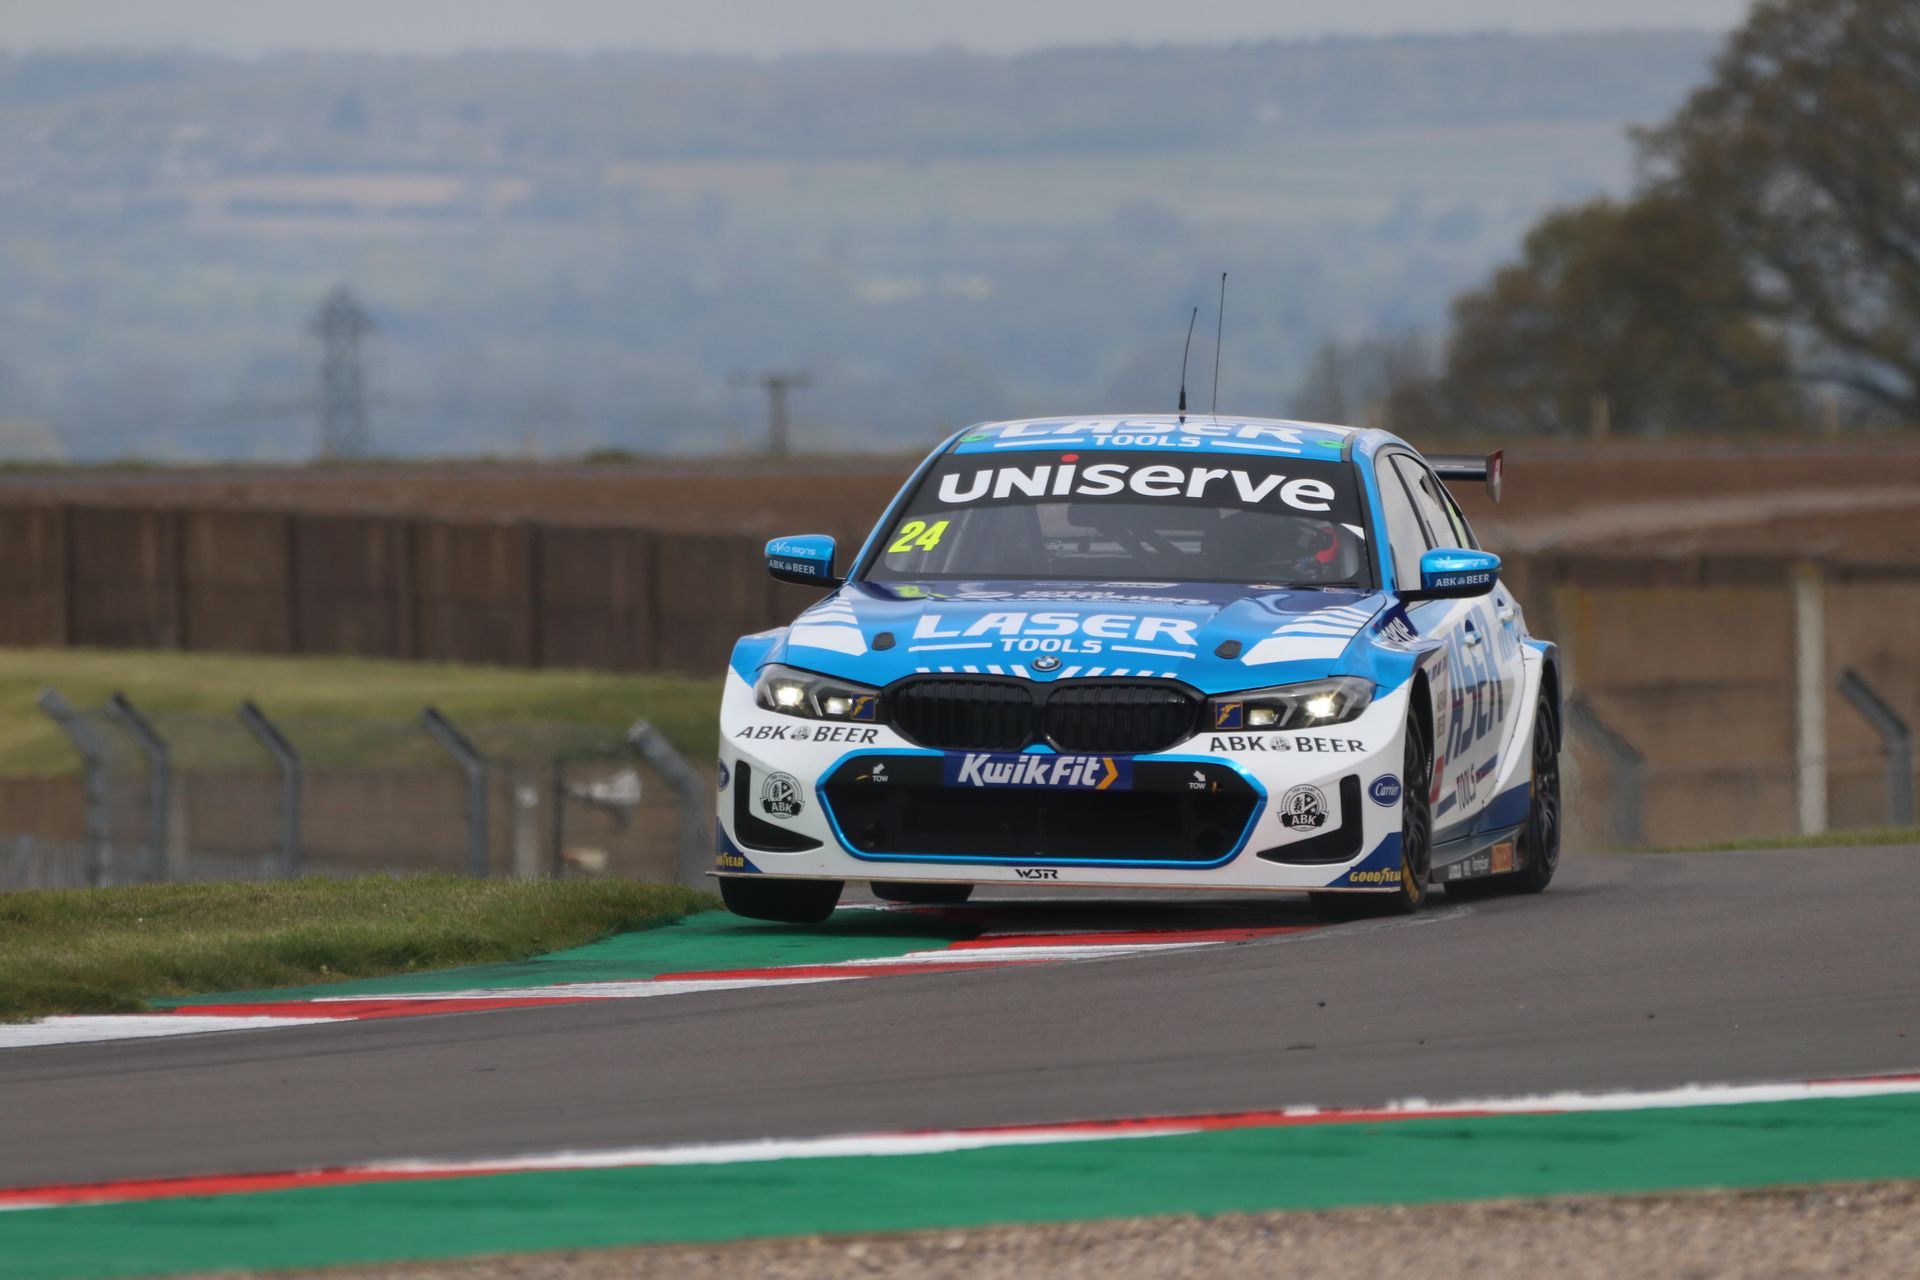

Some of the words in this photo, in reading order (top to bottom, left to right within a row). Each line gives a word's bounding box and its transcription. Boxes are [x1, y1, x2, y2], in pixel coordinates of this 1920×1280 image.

[1000, 418, 1304, 444] LASER
[1093, 434, 1201, 447] TOOLS
[888, 520, 950, 553] 24
[768, 559, 786, 571] ABK
[792, 563, 817, 575] BEER
[1435, 577, 1458, 588] ABK
[1466, 573, 1491, 585] BEER
[912, 612, 1199, 647] LASER
[1000, 638, 1103, 653] TOOLS
[735, 725, 792, 741] ABK
[813, 726, 880, 744] BEER
[1209, 736, 1269, 752] ABK
[1295, 736, 1368, 753] BEER
[872, 775, 889, 783] TOW
[1188, 782, 1207, 790] TOW
[1375, 782, 1400, 797] Carrier
[771, 802, 793, 814] ABK
[1291, 814, 1317, 826] ABK
[1014, 868, 1058, 879] WSR
